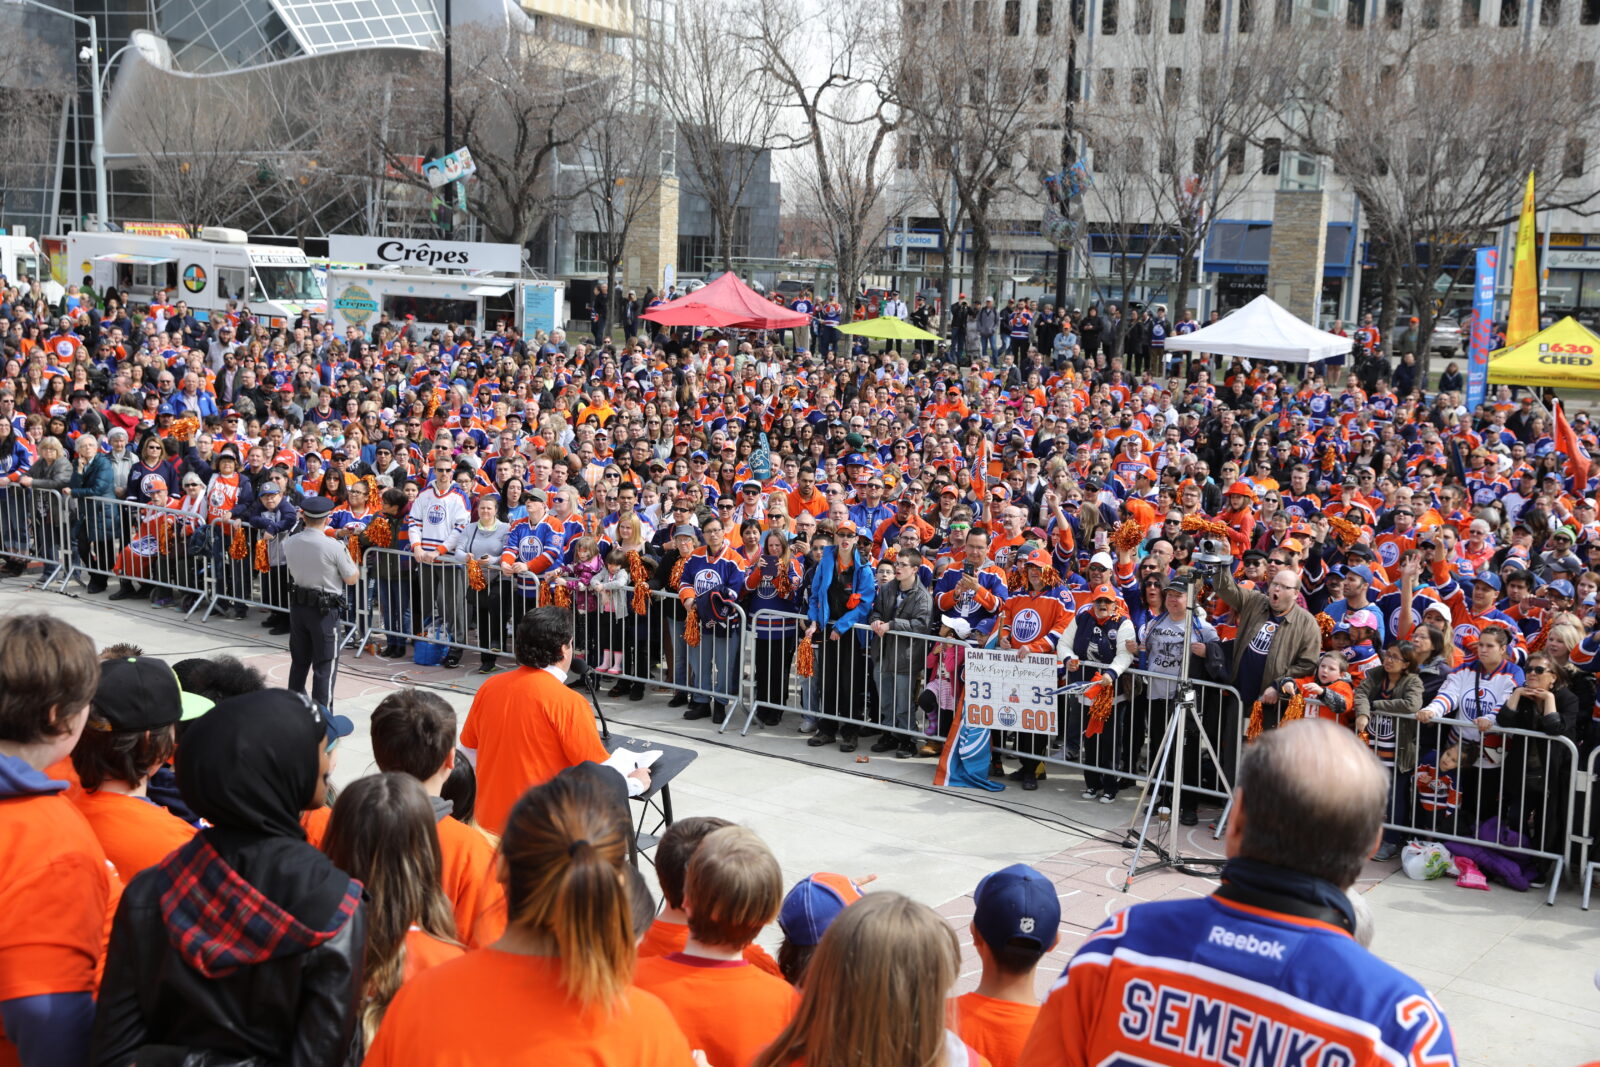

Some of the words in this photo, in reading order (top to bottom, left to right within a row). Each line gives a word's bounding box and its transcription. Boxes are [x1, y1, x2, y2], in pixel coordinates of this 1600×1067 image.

[377, 241, 469, 266] Crêpes
[1551, 344, 1594, 354] 630
[1538, 355, 1593, 366] CHED
[697, 579, 718, 590] OILERS
[1016, 619, 1037, 631] OILERS
[967, 651, 984, 660] CAM
[1028, 655, 1054, 665] TALBOT
[1153, 657, 1182, 668] ROCKY
[967, 662, 987, 673] PINK
[969, 681, 991, 699] 33
[1032, 686, 1054, 705] 33
[968, 704, 994, 726] GO
[1022, 709, 1056, 732] GO!
[1208, 926, 1286, 960] Reebok
